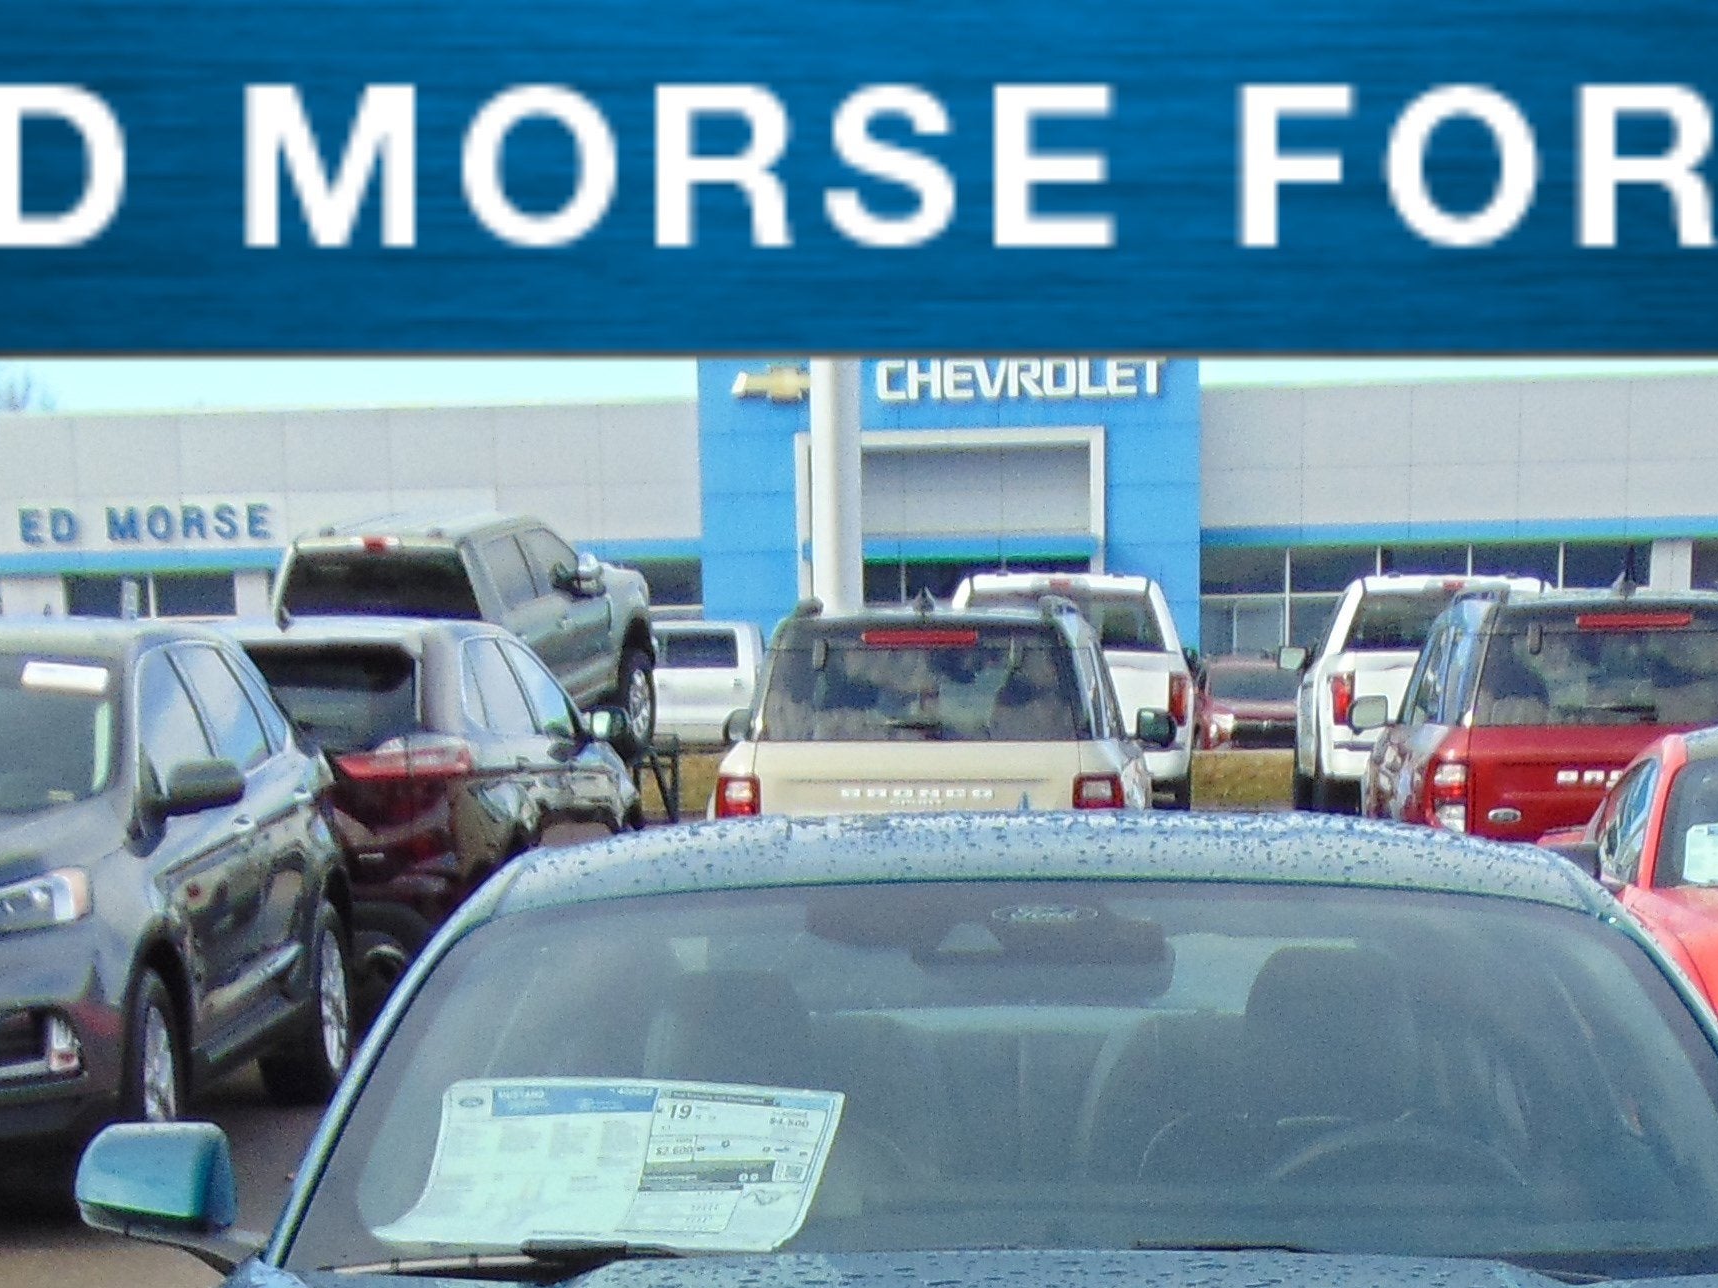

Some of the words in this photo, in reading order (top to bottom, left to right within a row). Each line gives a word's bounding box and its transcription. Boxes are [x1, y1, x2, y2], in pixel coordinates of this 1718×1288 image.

[875, 357, 1165, 401] CHEVROLET
[18, 507, 78, 544] ED
[105, 503, 271, 543] MORSE
